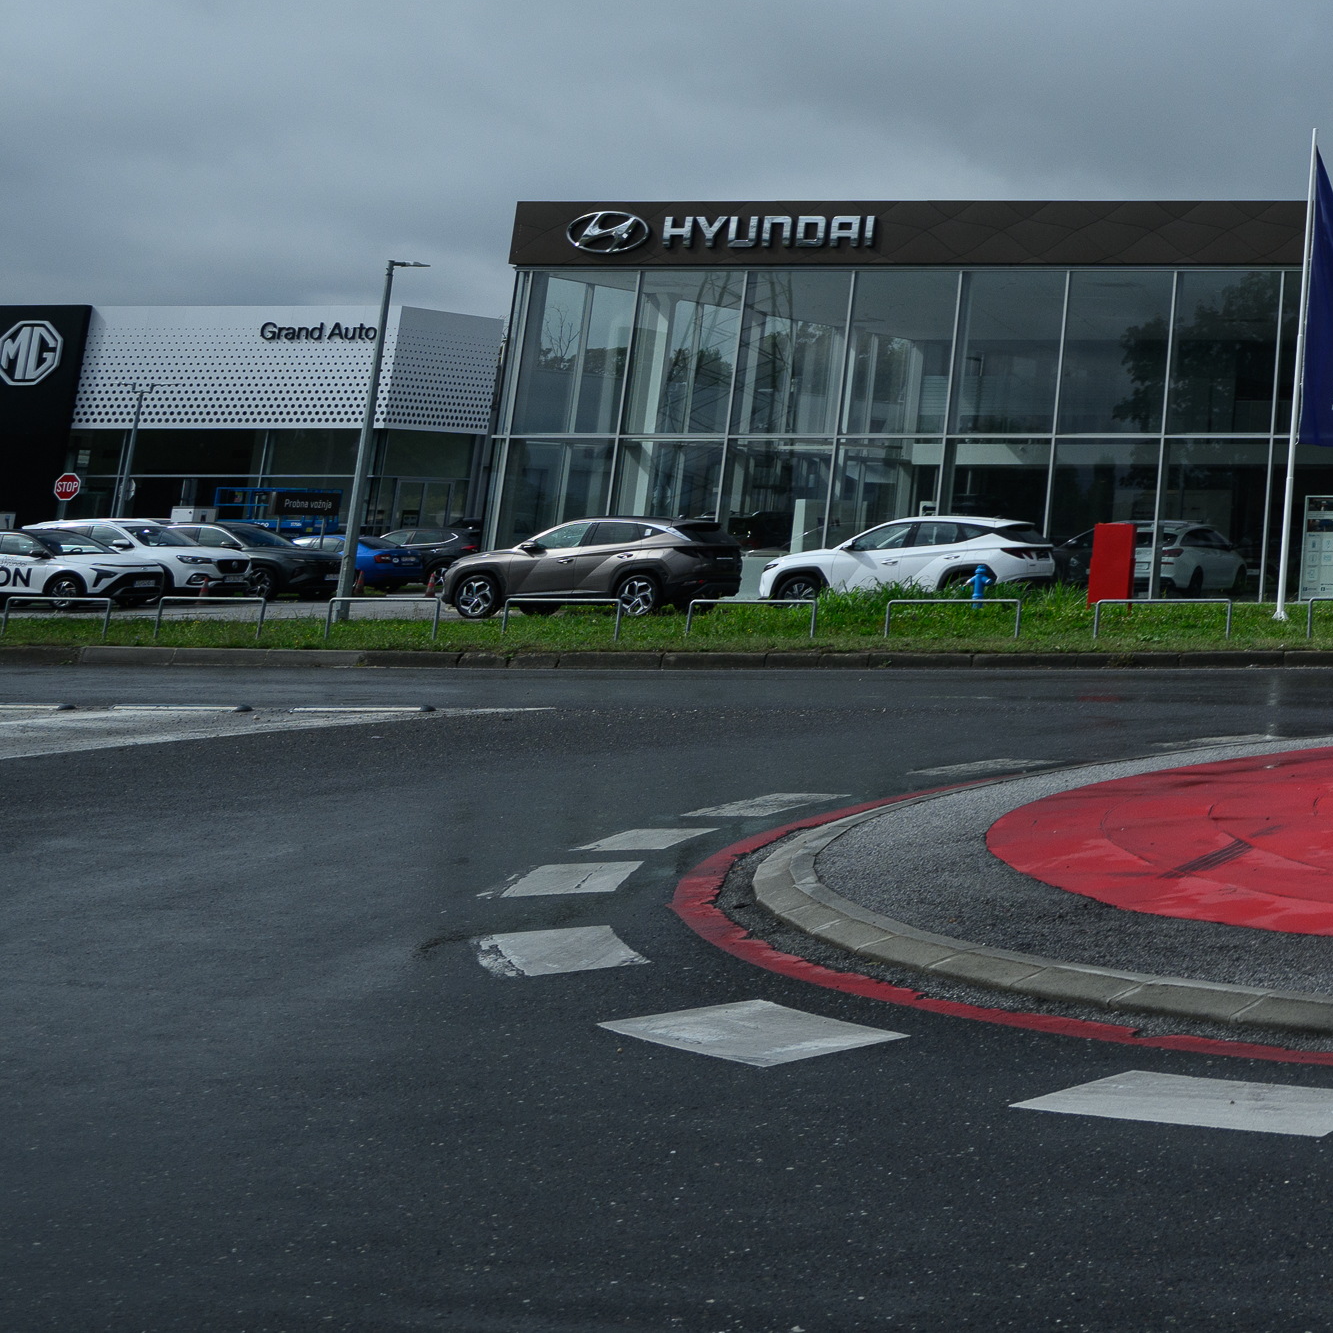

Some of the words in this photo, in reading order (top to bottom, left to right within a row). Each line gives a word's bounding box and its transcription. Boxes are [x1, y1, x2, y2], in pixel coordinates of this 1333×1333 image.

[662, 216, 876, 248] HYUNDAI
[260, 322, 324, 340] Grand
[326, 322, 378, 340] Auto
[1, 326, 57, 380] MG
[56, 481, 79, 492] STOP
[284, 499, 308, 508] Probna
[310, 501, 332, 511] vožnja
